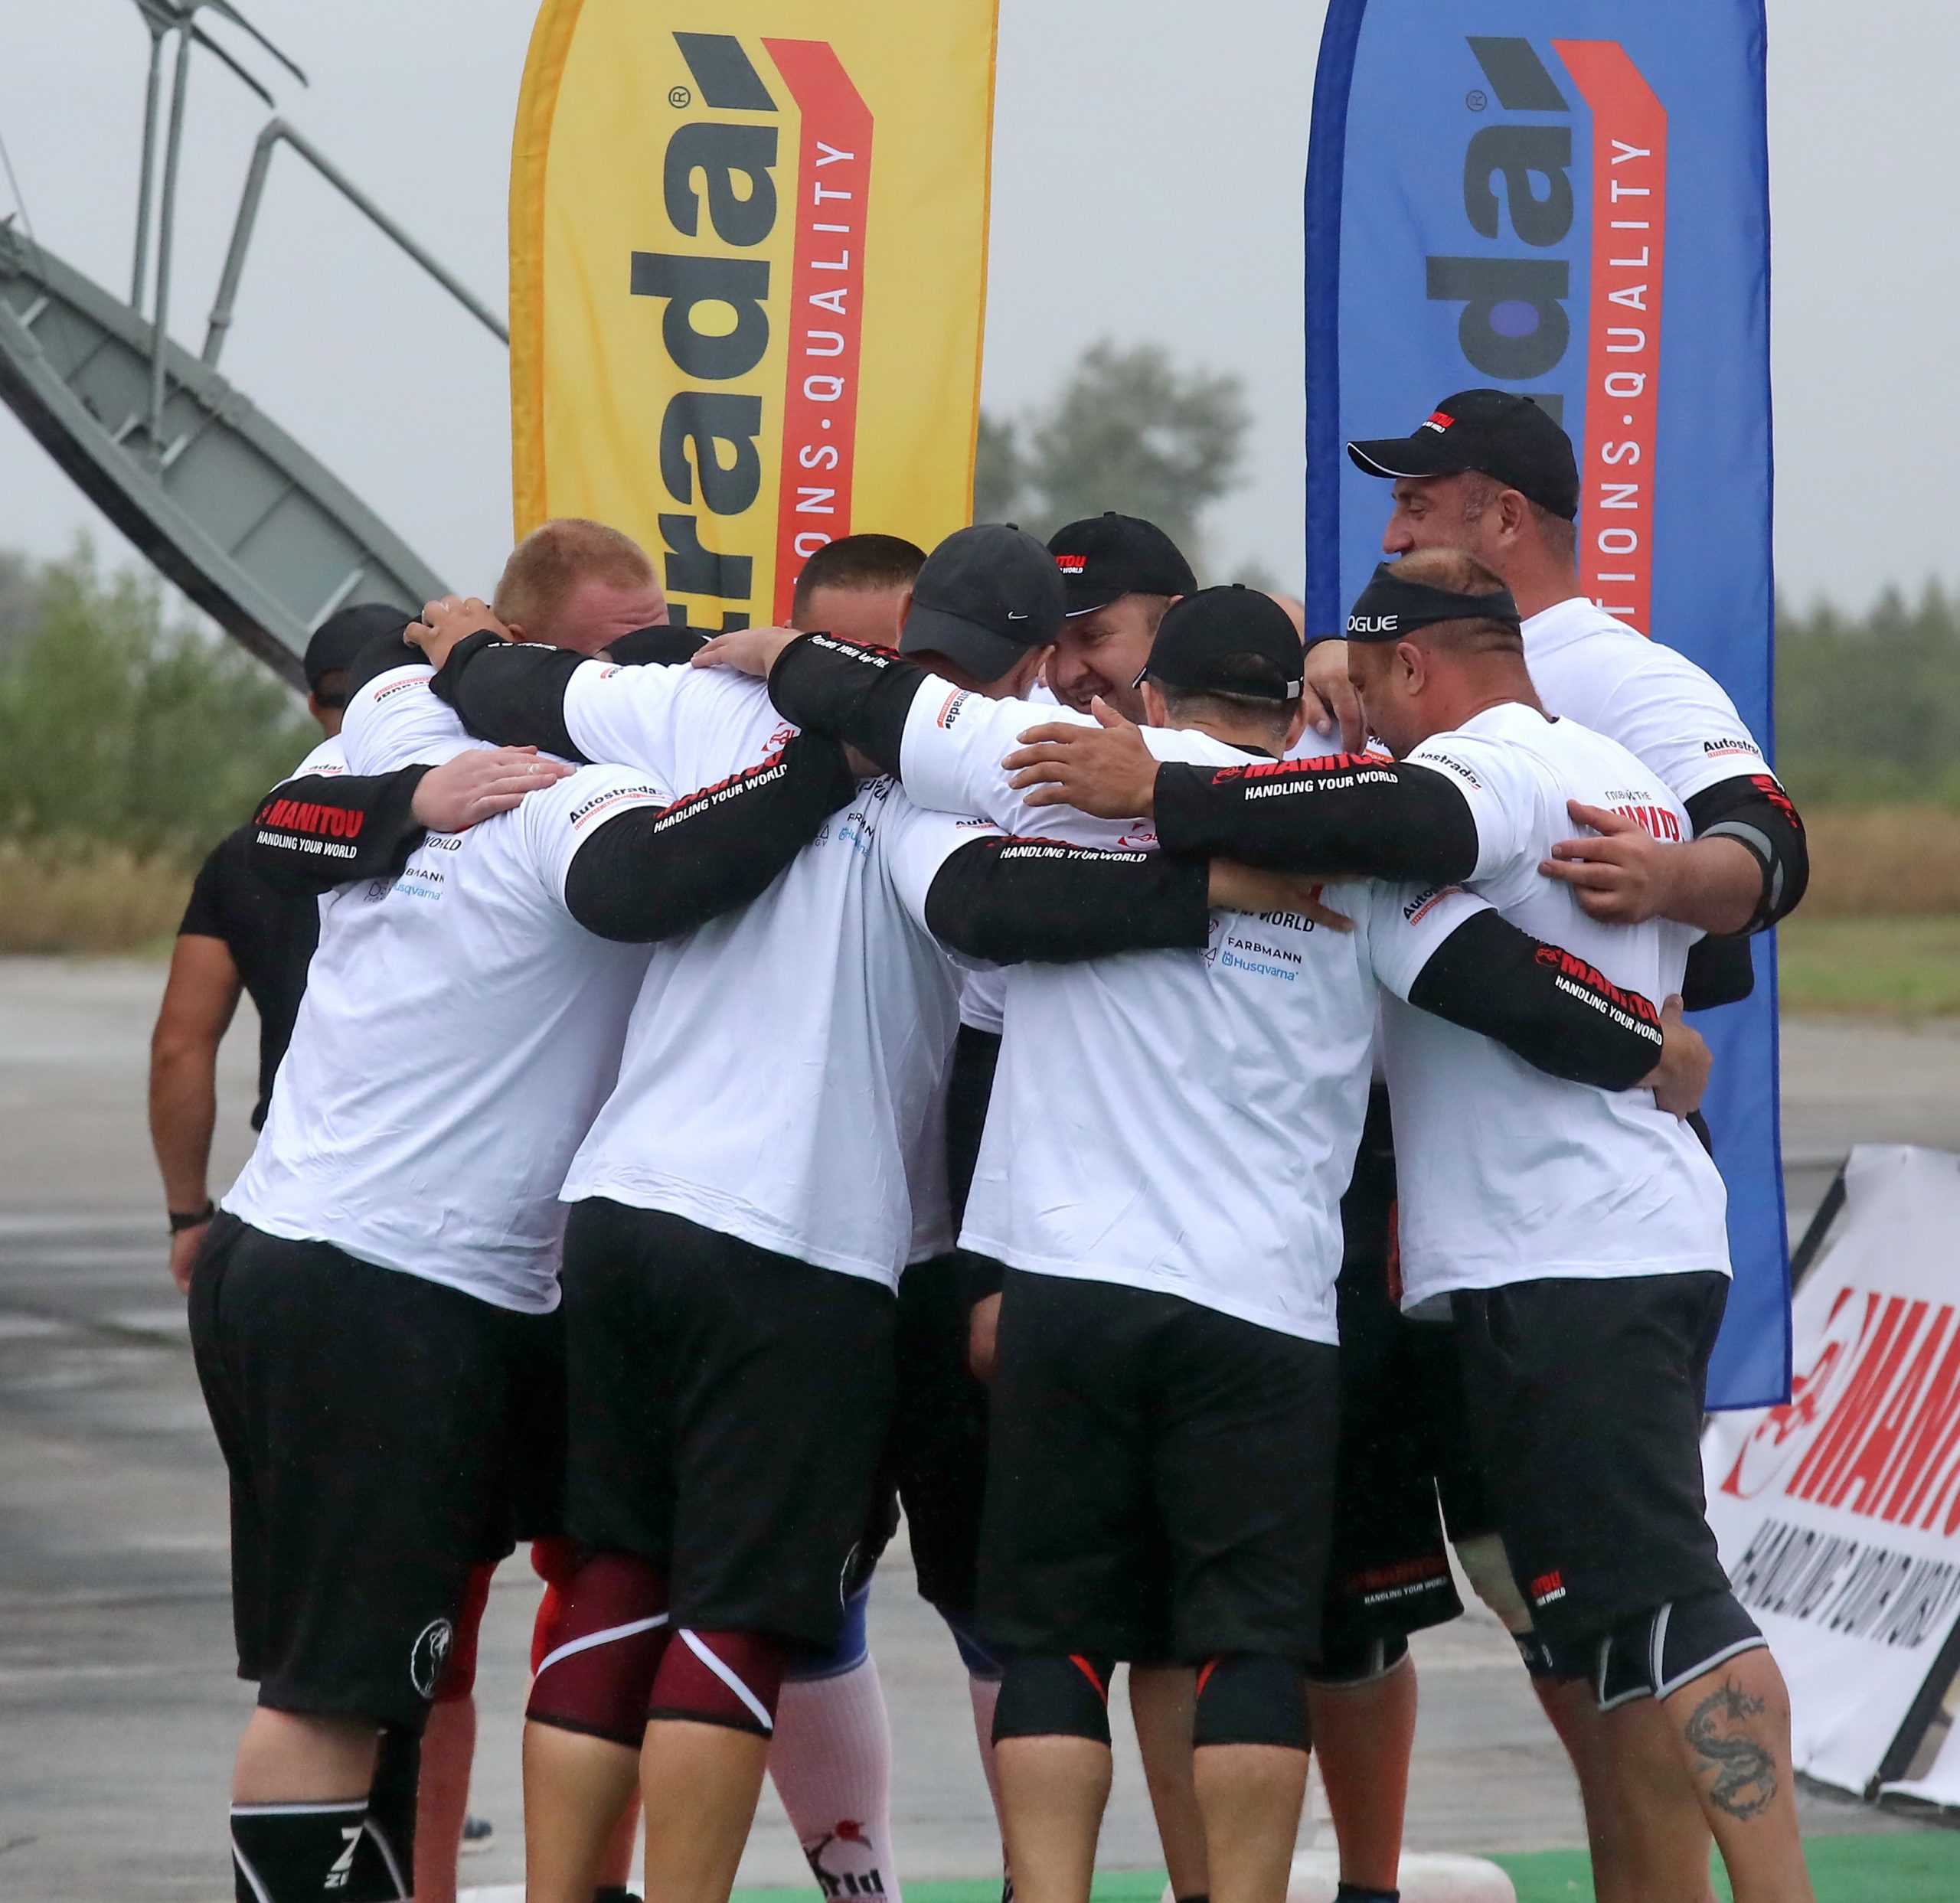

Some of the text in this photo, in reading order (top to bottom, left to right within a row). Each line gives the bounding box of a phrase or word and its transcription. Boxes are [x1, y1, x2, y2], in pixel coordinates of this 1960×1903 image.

[1348, 615, 1398, 632] OGUE
[1245, 770, 1399, 801] HANDLING YOUR WORLD
[266, 798, 364, 839] MANITOU
[653, 798, 709, 834] HANDLING
[710, 782, 744, 806] YOUR
[256, 831, 358, 860] HANDLING YOUR WORLD
[999, 846, 1065, 860] HANDLING
[1099, 850, 1148, 863] WORLD
[1227, 936, 1302, 965] FARBMANN
[1233, 957, 1295, 981] Husqvarna
[1555, 974, 1608, 1014] HANDLING
[1609, 1005, 1635, 1031] YOUR
